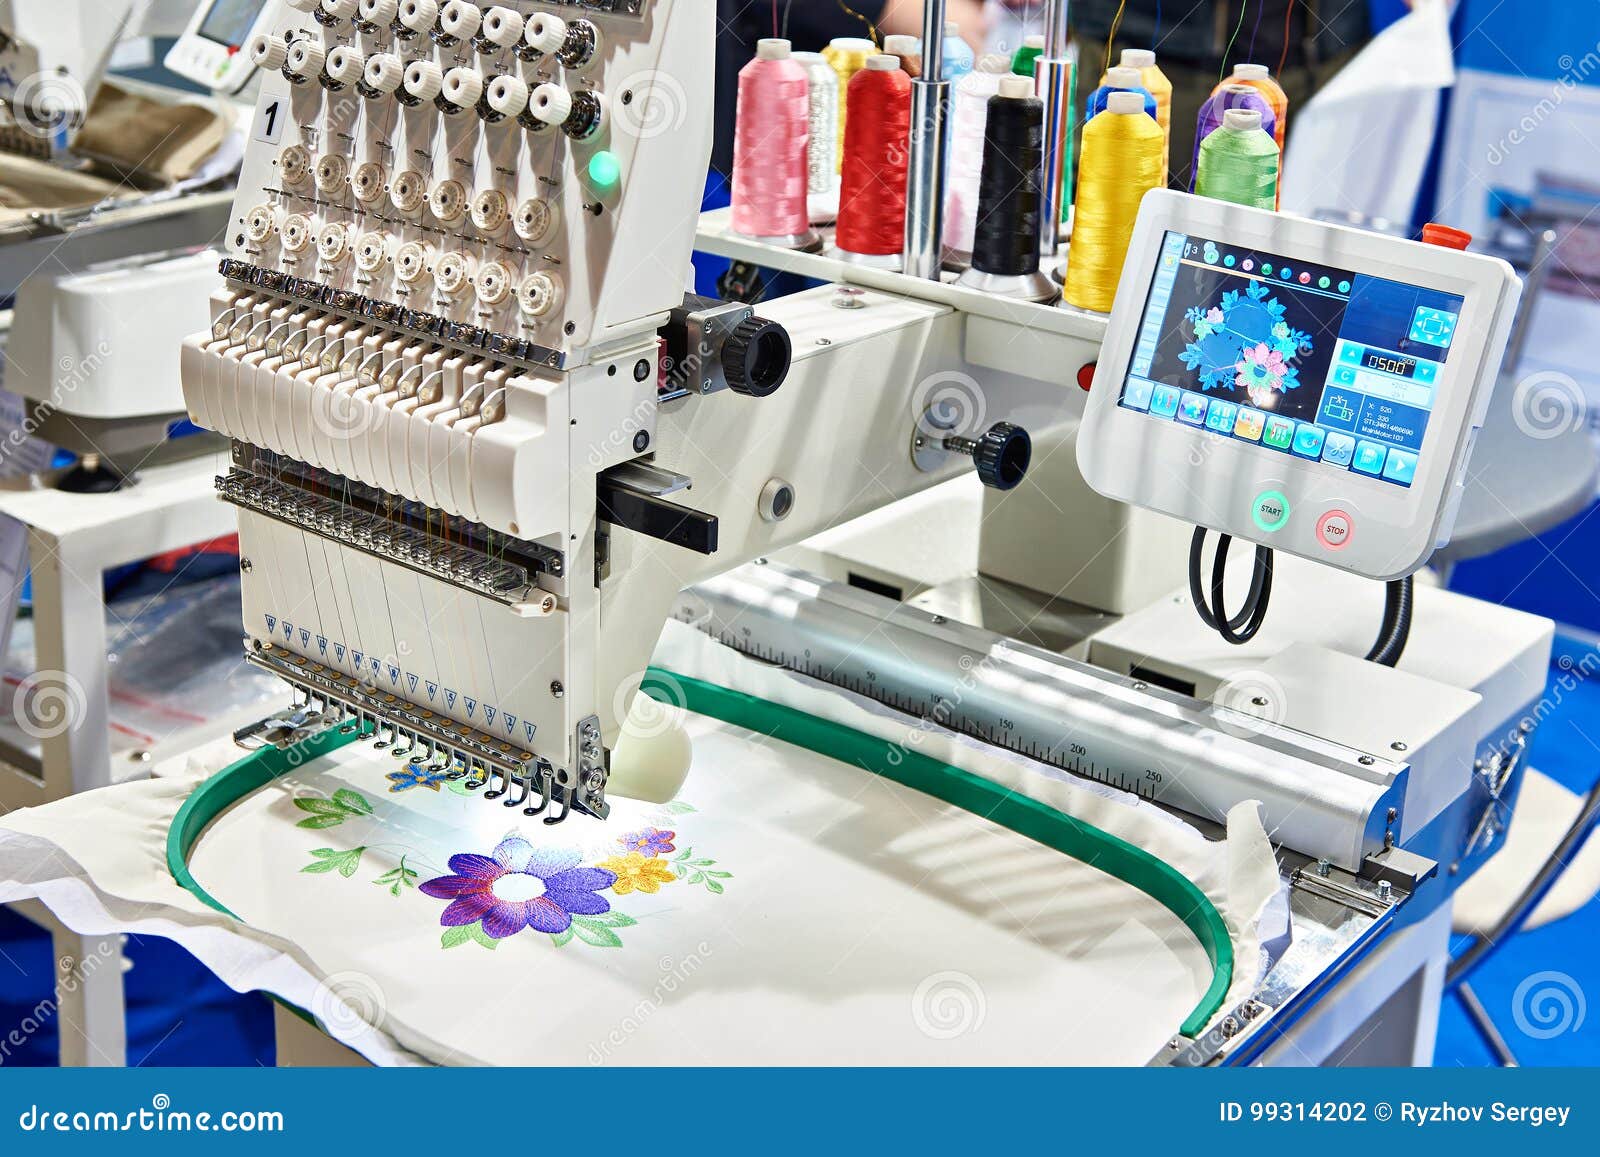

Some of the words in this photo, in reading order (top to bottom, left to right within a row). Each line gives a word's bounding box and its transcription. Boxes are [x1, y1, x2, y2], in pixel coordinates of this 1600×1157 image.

[264, 101, 279, 136] 1
[1368, 355, 1405, 375] 0500
[1260, 504, 1282, 517] START
[1326, 525, 1345, 536] STOP
[866, 671, 876, 682] 50
[1000, 718, 1014, 730] 150
[1070, 743, 1086, 756] 200
[1145, 769, 1162, 783] 250
